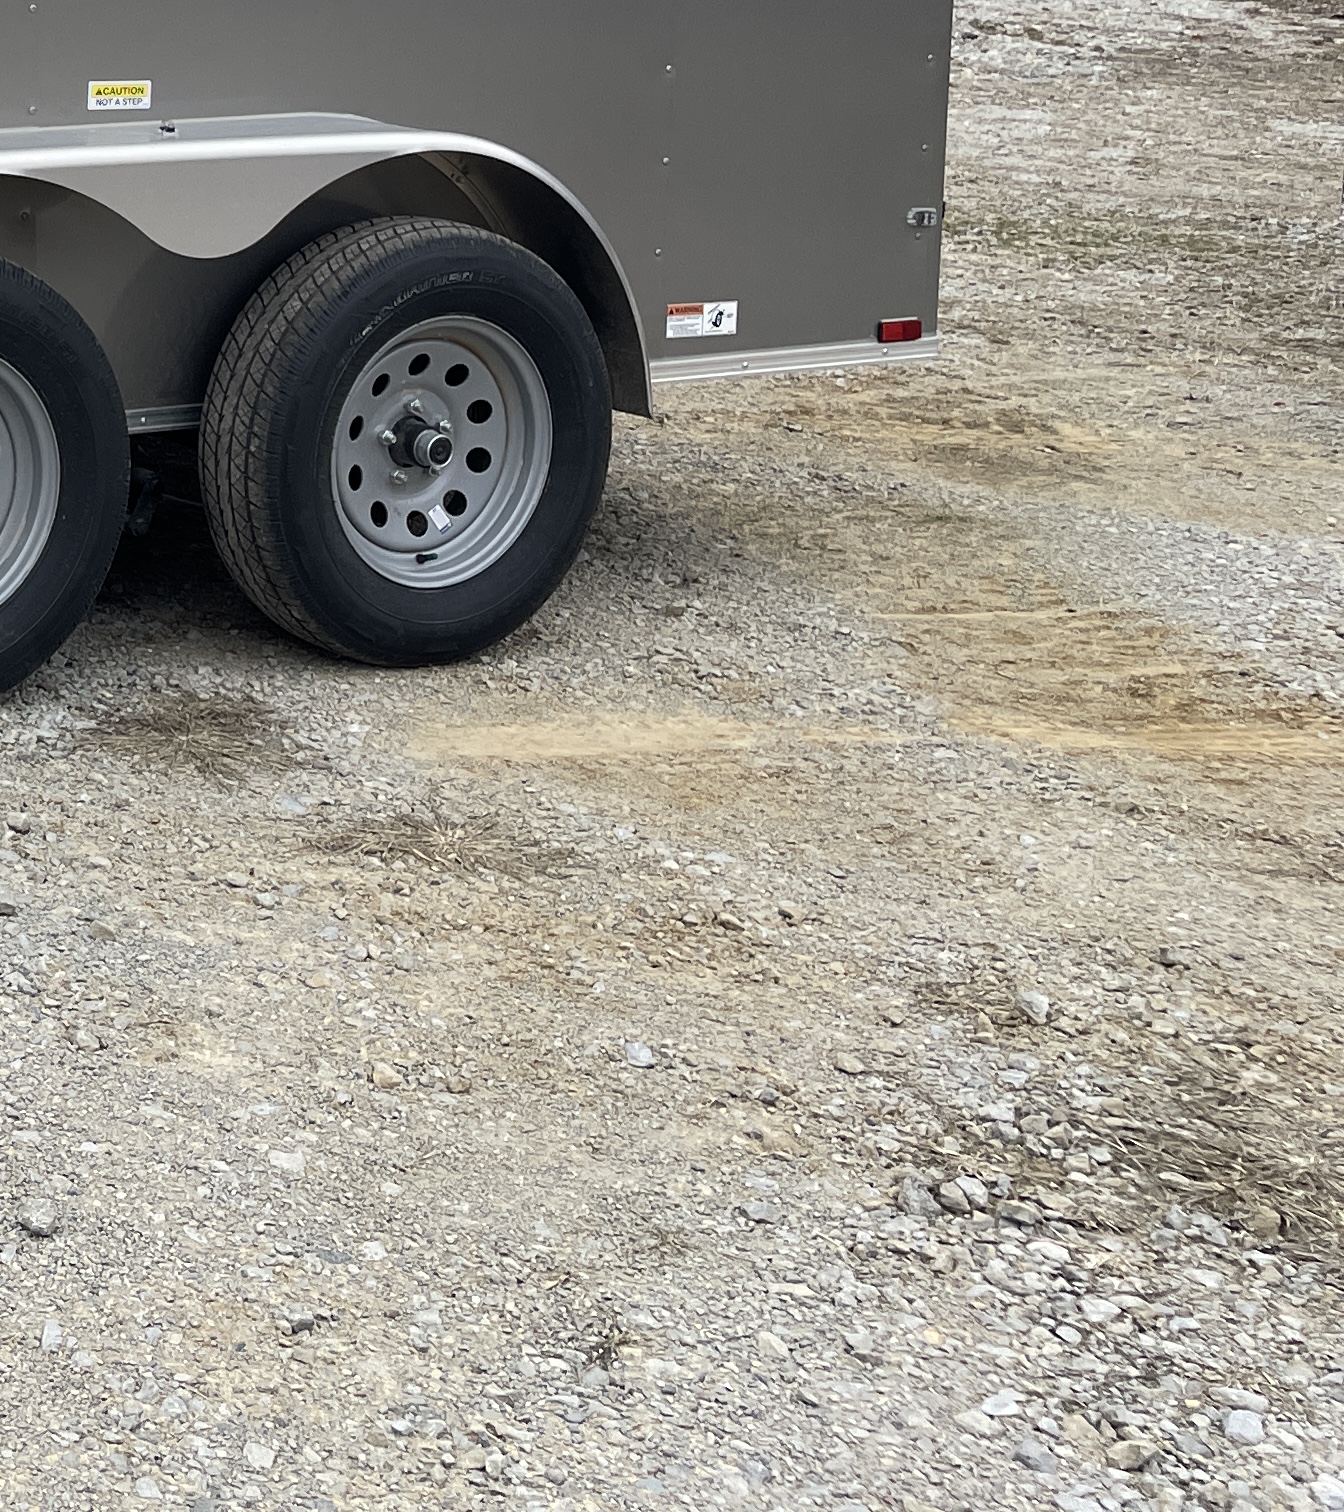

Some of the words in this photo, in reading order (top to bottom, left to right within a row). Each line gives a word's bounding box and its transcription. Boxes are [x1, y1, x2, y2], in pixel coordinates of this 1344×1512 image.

[102, 86, 145, 96] CAUTION
[95, 98, 114, 107] NOT
[114, 98, 121, 106] A
[122, 97, 143, 106] STEP
